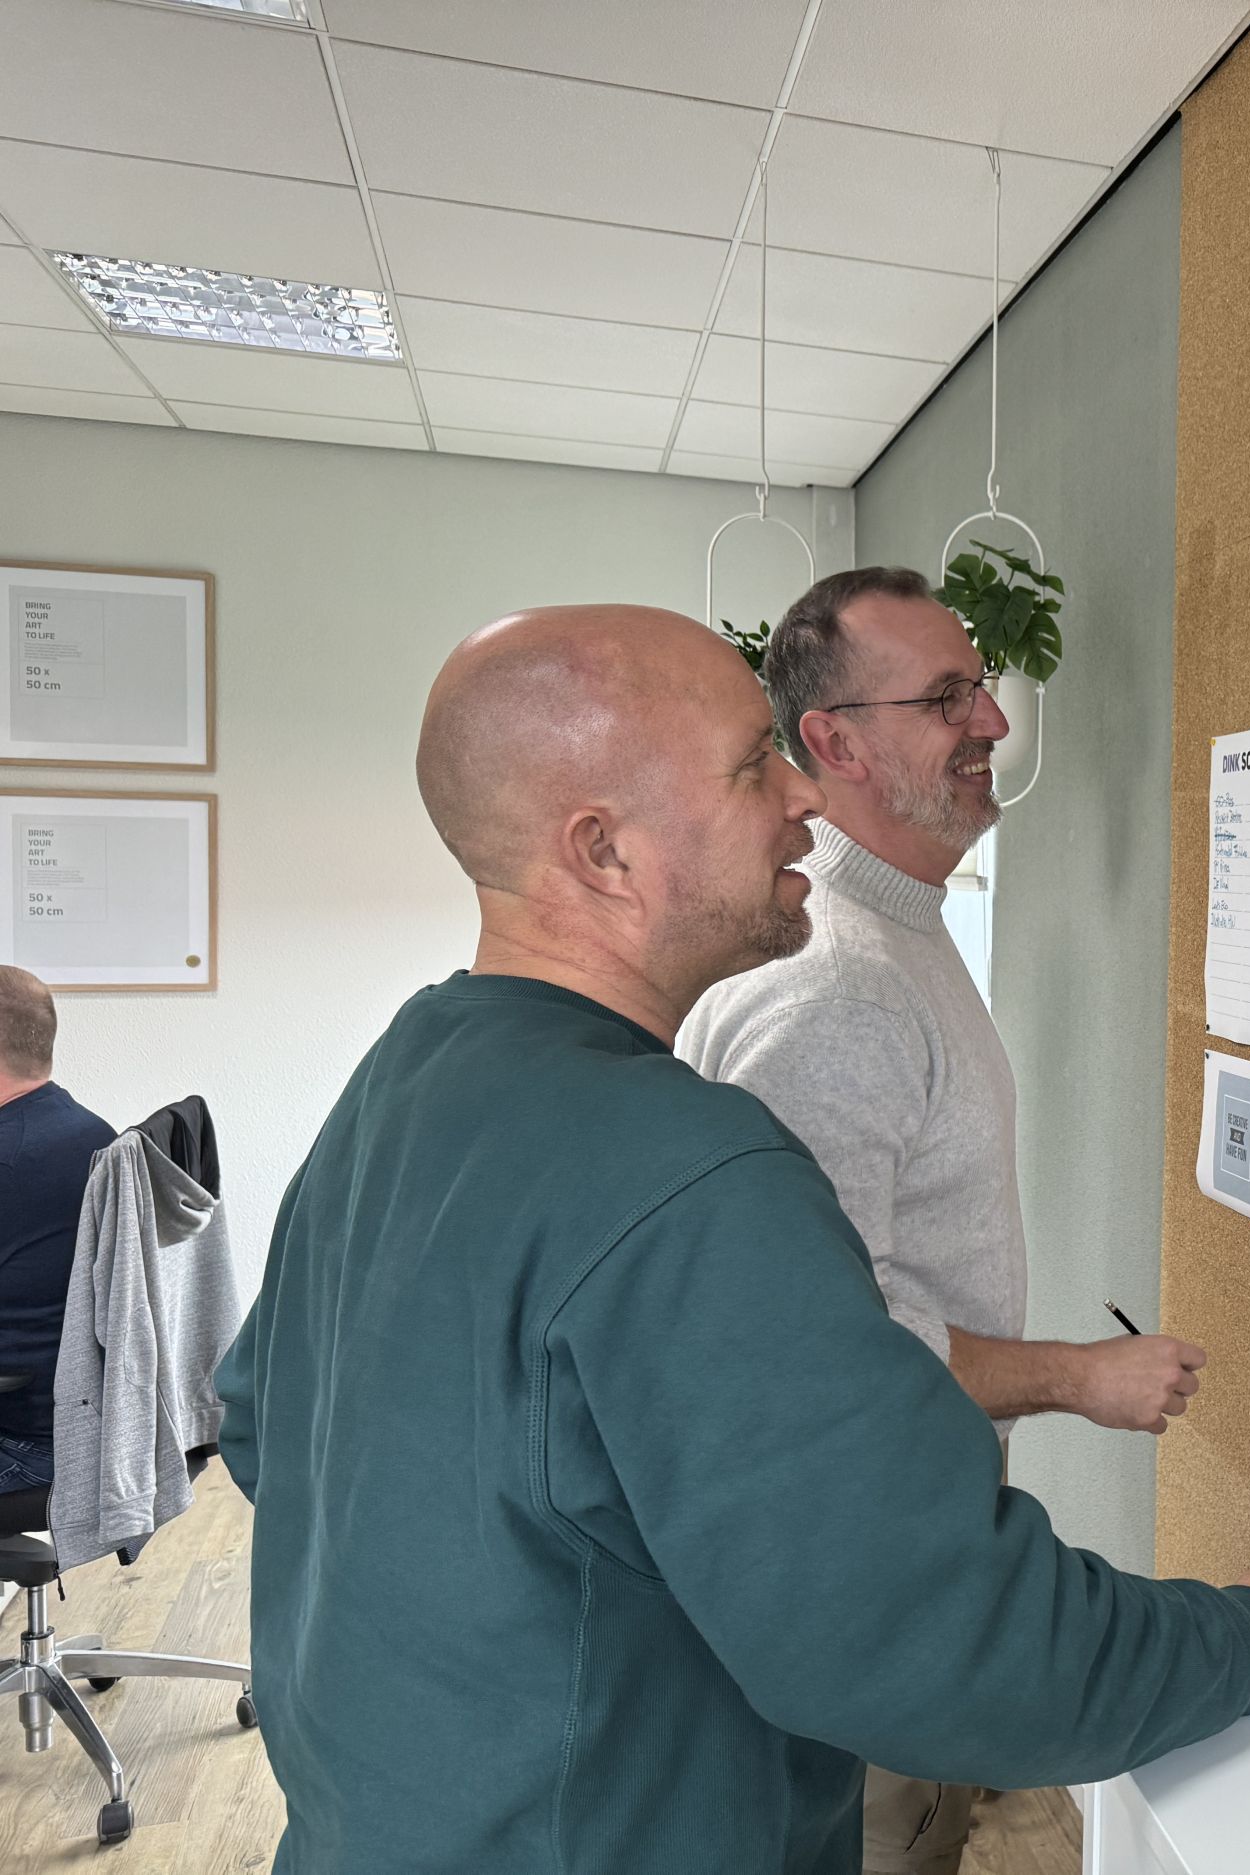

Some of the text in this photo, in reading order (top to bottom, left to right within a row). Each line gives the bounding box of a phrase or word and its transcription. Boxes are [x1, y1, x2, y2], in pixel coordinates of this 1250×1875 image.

[25, 601, 51, 610] BRING
[25, 611, 48, 620] YOUR
[25, 621, 42, 629] ART
[26, 631, 55, 640] TO LIFE
[26, 666, 50, 676] 50 x
[26, 680, 61, 690] 50 cm
[1222, 752, 1240, 774] DINK
[28, 829, 54, 837] BRING
[28, 839, 52, 847] YOUR
[28, 858, 58, 866] TO LIFE
[29, 893, 53, 902] 50 x
[29, 907, 64, 916] 50 cm
[1232, 1114, 1248, 1130] CREATIVE
[1226, 1143, 1247, 1162] HAVE FUN
